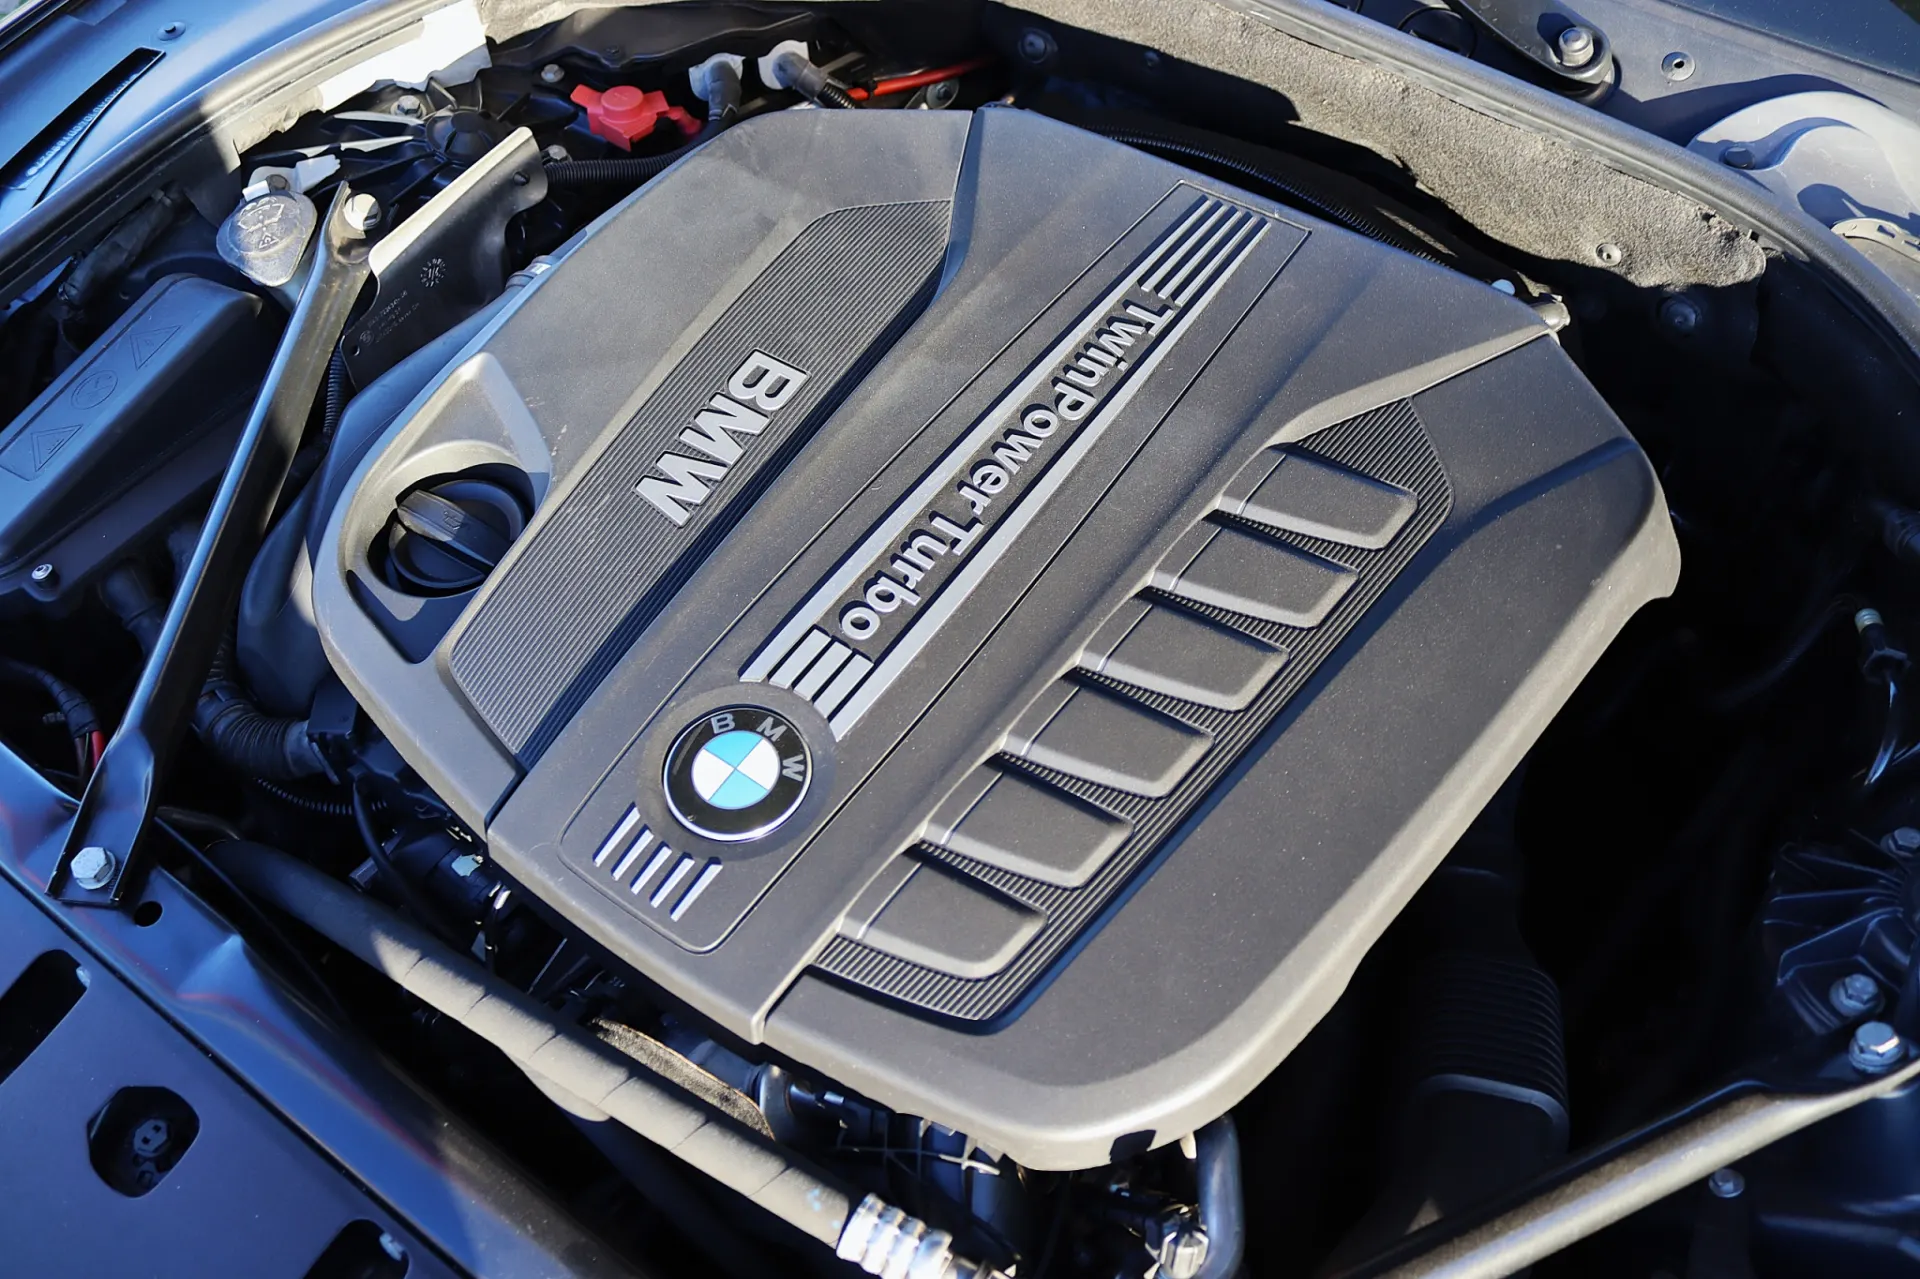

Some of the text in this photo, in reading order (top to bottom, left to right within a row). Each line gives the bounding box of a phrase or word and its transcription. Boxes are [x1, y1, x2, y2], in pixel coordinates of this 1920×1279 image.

[635, 349, 809, 526] BMW
[840, 303, 1175, 641] TwinPower Turbo
[711, 712, 805, 782] BMW
